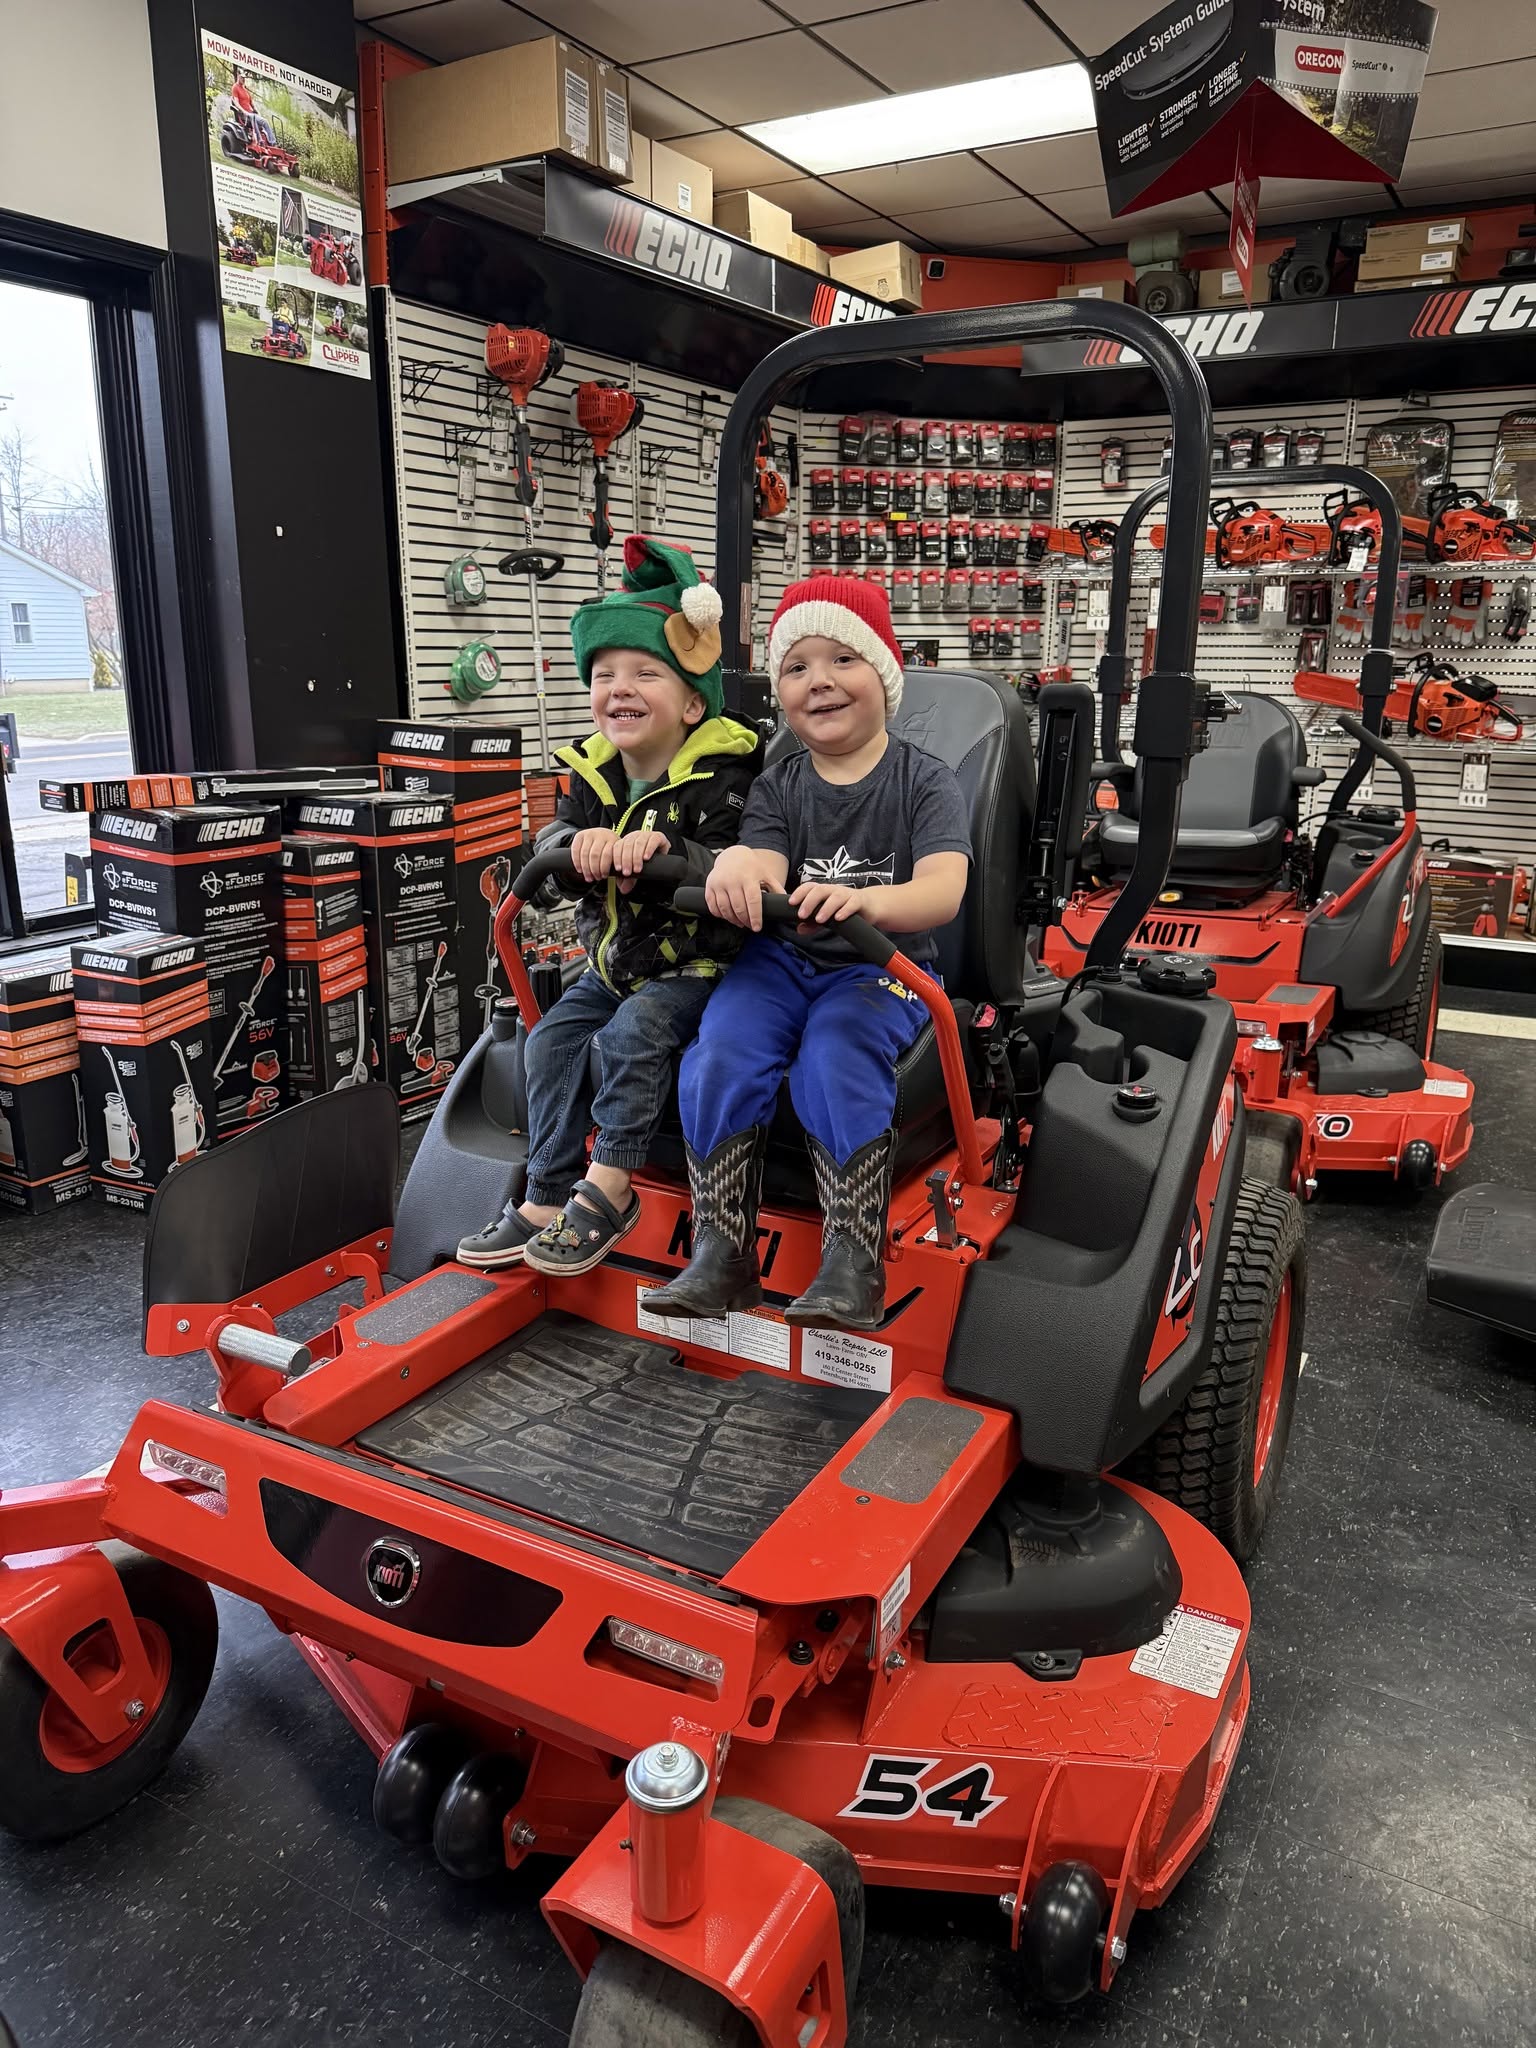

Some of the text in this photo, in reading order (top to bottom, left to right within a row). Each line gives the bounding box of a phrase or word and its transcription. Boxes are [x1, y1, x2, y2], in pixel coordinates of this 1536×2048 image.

[1276, 0, 1326, 23] ystem
[1095, 0, 1231, 90] SpeedCut System Gui
[206, 38, 333, 98] MOW SMARTER, NOT HARDER
[1297, 50, 1342, 69] OREGON
[1209, 70, 1239, 99] LASTING
[1224, 78, 1243, 97] durability
[1159, 90, 1198, 123] STRONGER
[1183, 102, 1199, 116] rigidity
[1117, 123, 1148, 149] LIGHTER
[1169, 118, 1184, 135] control
[1119, 135, 1149, 157] Easy handling
[1139, 141, 1152, 155] effort
[635, 210, 732, 290] ECHO
[1454, 282, 1536, 334] EC
[323, 344, 360, 364] CLIPPER
[404, 731, 445, 751] ECHO
[480, 739, 512, 754] ECHO
[310, 806, 355, 827] ECHO
[400, 805, 445, 826] ECHO
[113, 817, 158, 842] ECHO
[214, 817, 265, 842] ECHO
[324, 851, 354, 866] ECHO
[225, 873, 265, 886] eFORCE
[400, 881, 443, 896] DCP-BVRVS1
[108, 898, 157, 917] DCP-BVRVS1
[205, 900, 261, 917] DCP-BVRVS1
[1134, 920, 1202, 948] KIOTI
[91, 955, 128, 972] ECHO
[160, 947, 196, 969] ECHO
[249, 1026, 275, 1043] 56V
[807, 1328, 888, 1358] Charlie's Repair LLC
[815, 1349, 877, 1375] 419-346-0255
[820, 1368, 848, 1383] Petersburg,
[835, 1367, 853, 1377] Center
[853, 1372, 870, 1383] Street
[373, 1562, 406, 1589] KIOTI
[1186, 1606, 1228, 1624] DANGER
[836, 1754, 1008, 1828] 54
